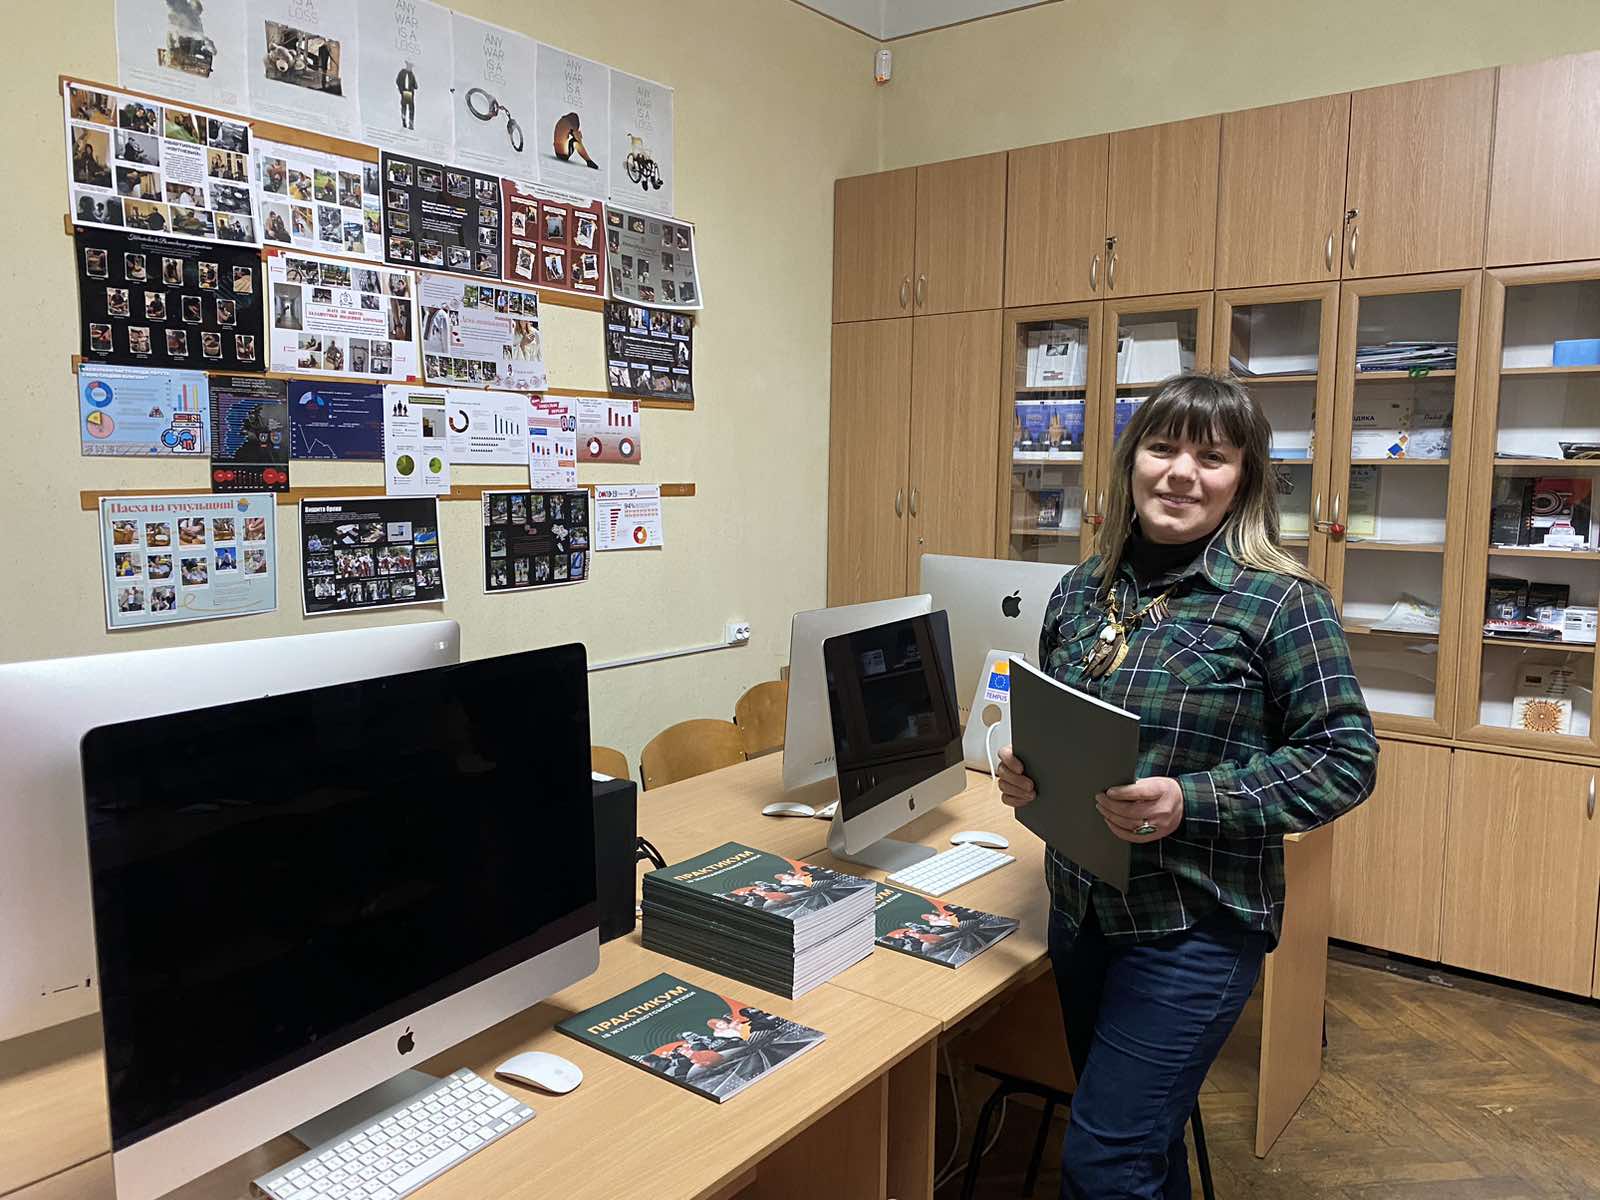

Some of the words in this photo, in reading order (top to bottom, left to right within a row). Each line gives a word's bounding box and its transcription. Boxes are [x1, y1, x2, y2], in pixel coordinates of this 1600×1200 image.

[395, 0, 417, 16] ANY
[394, 11, 419, 27] WAR
[398, 26, 408, 39] IS
[409, 29, 417, 41] A
[484, 32, 504, 48] ANY
[483, 46, 505, 61] WAR
[487, 59, 495, 71] IS
[496, 63, 503, 73] A
[566, 59, 583, 72] ANY
[564, 70, 584, 85] WAR
[575, 86, 581, 96] A
[111, 502, 149, 514] Пасха
[151, 502, 165, 513] на
[986, 691, 1008, 702] TEMPUS
[673, 850, 755, 881] ПРАКТИКУМ
[587, 985, 689, 1035] ПРАКТИКУМ
